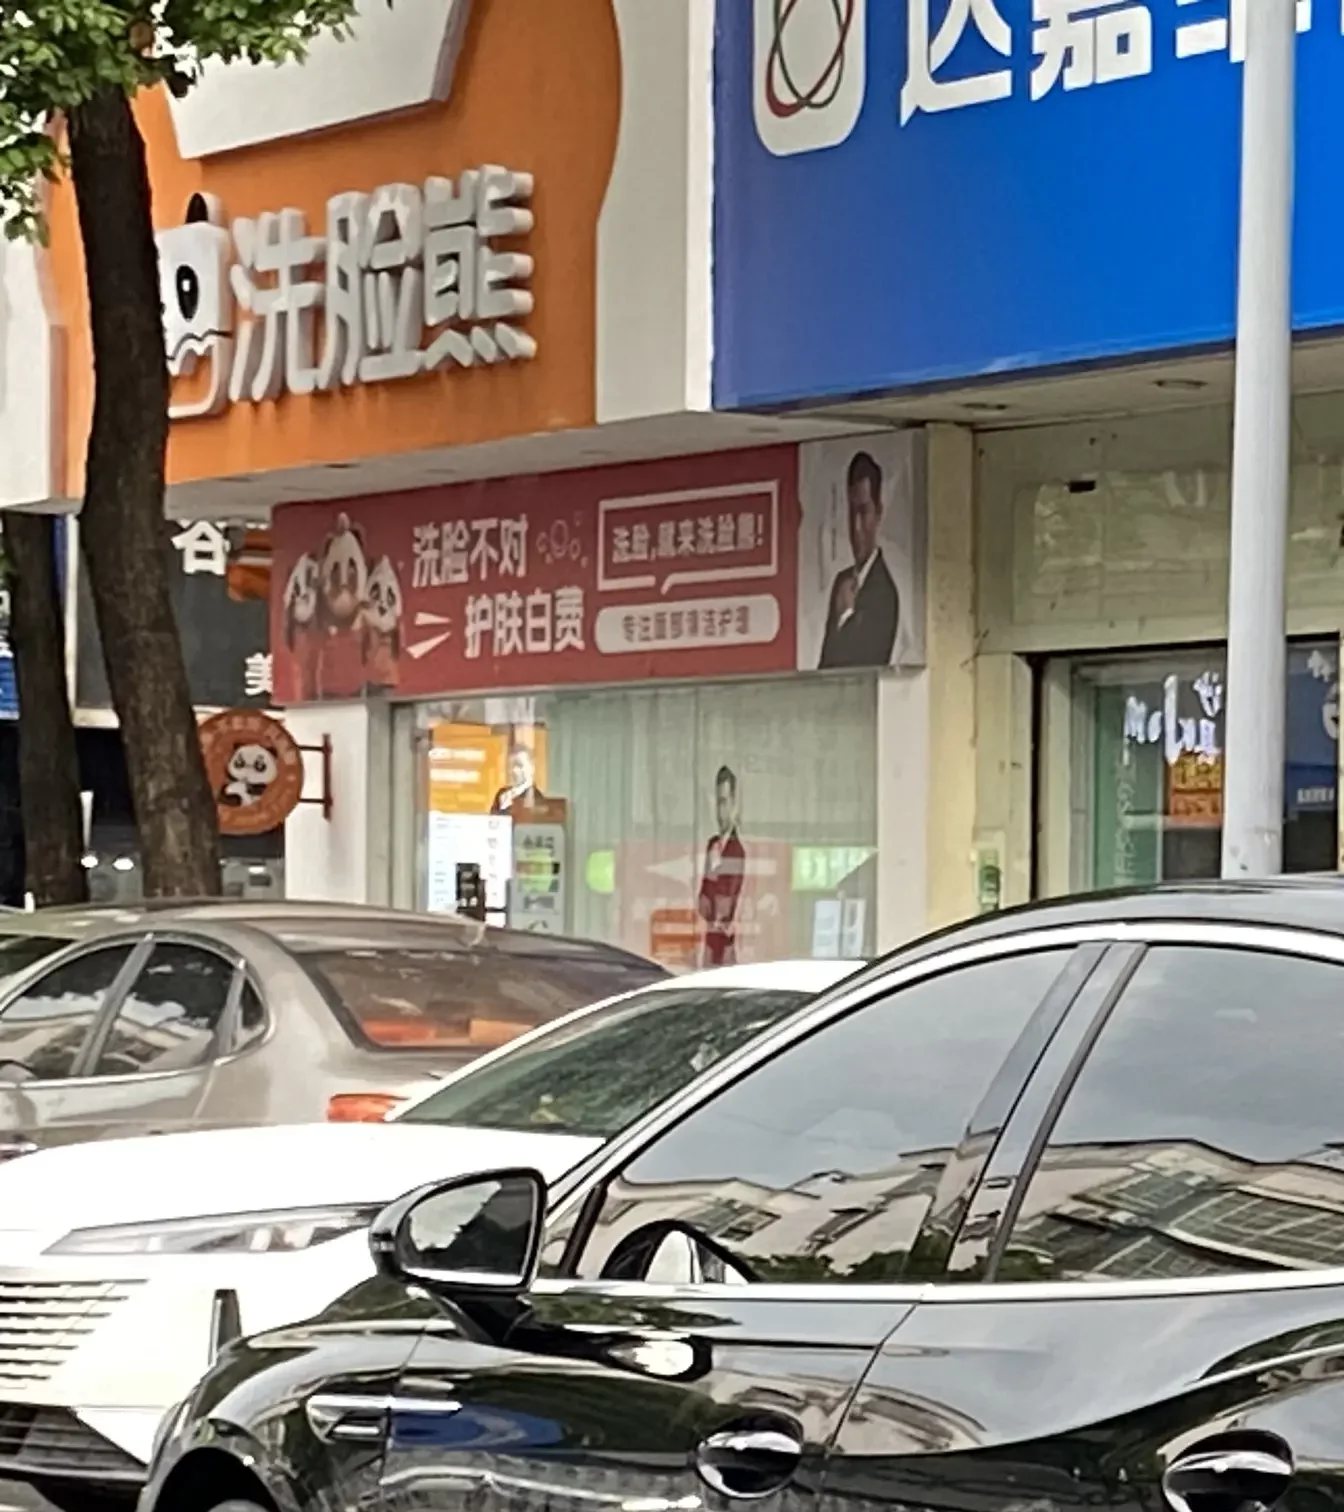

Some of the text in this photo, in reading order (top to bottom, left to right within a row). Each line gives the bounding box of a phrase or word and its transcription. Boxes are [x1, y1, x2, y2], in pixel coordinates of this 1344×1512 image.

[229, 163, 537, 405] 洗脸熊
[411, 513, 529, 589] 洗脸不对
[464, 585, 586, 659] 护肤白费
